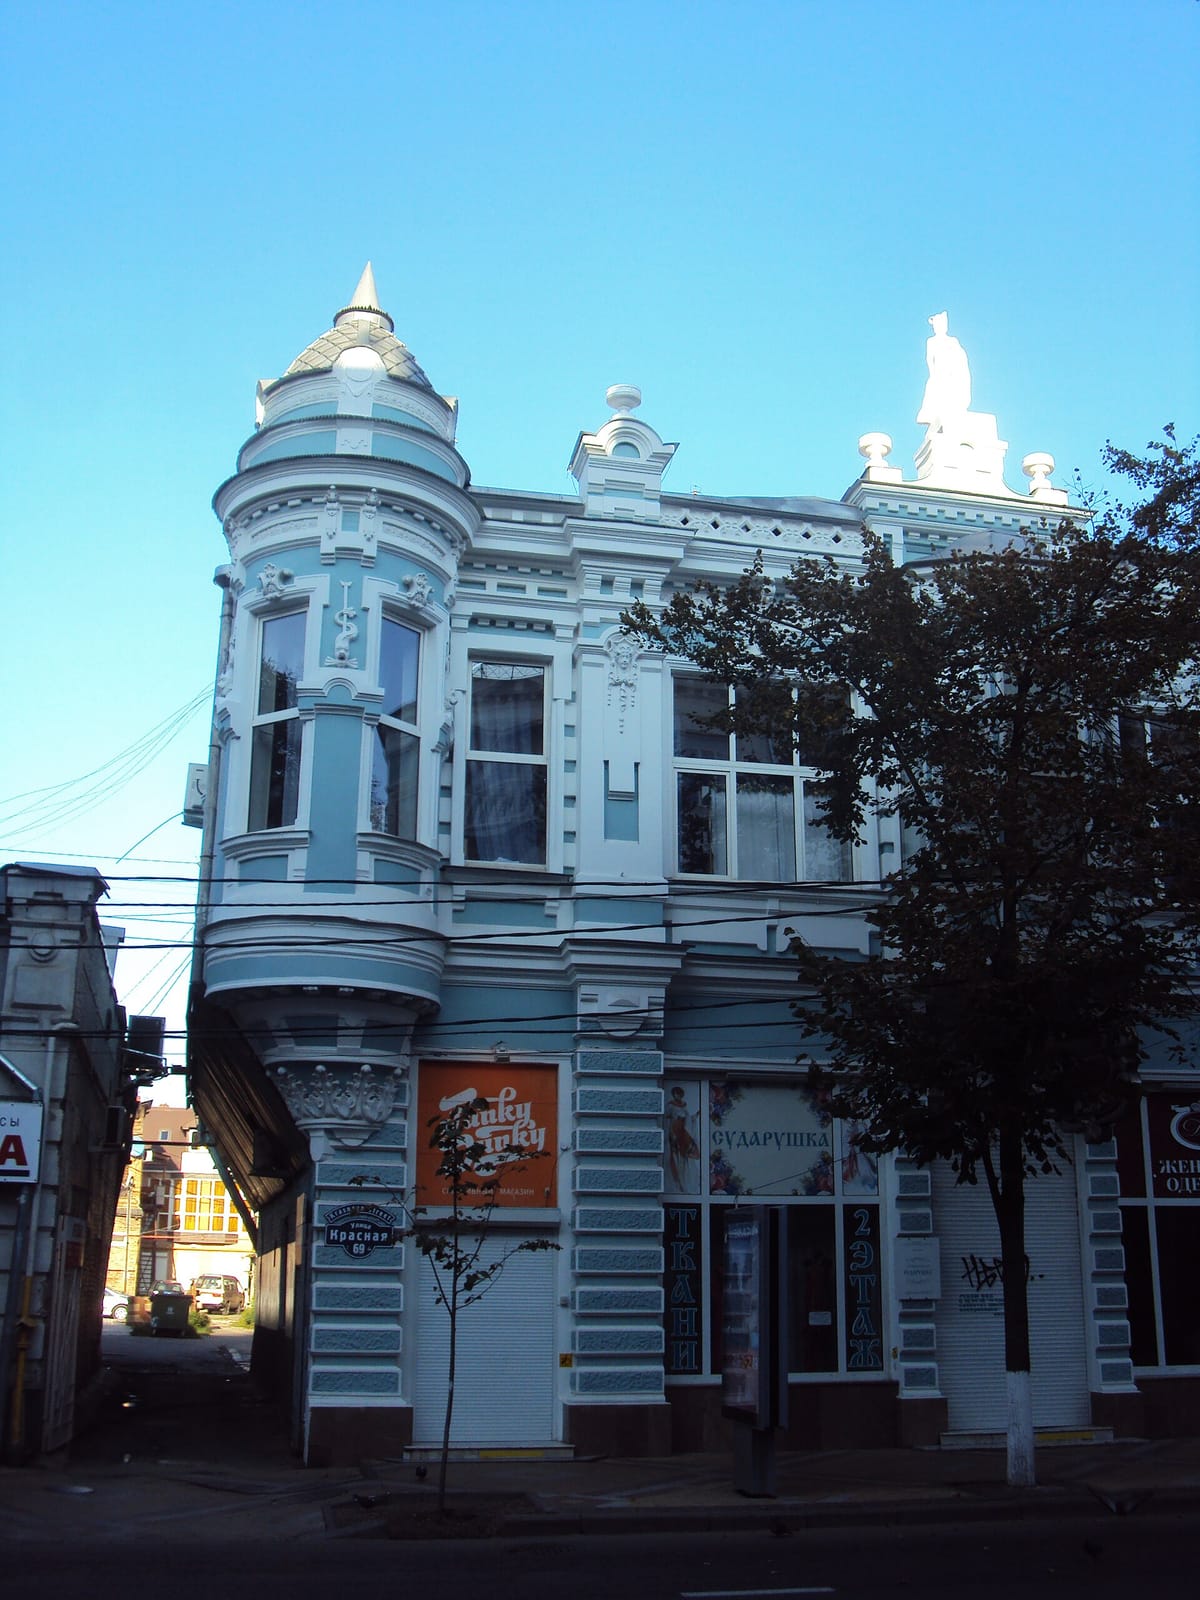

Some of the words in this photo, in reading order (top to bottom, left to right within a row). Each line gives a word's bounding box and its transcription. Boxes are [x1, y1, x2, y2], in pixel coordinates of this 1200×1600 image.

[712, 1130, 829, 1150] СУДАРУШКА
[329, 1229, 388, 1242] Красная
[352, 1243, 366, 1255] 69
[668, 1208, 699, 1371] ТКАНИ
